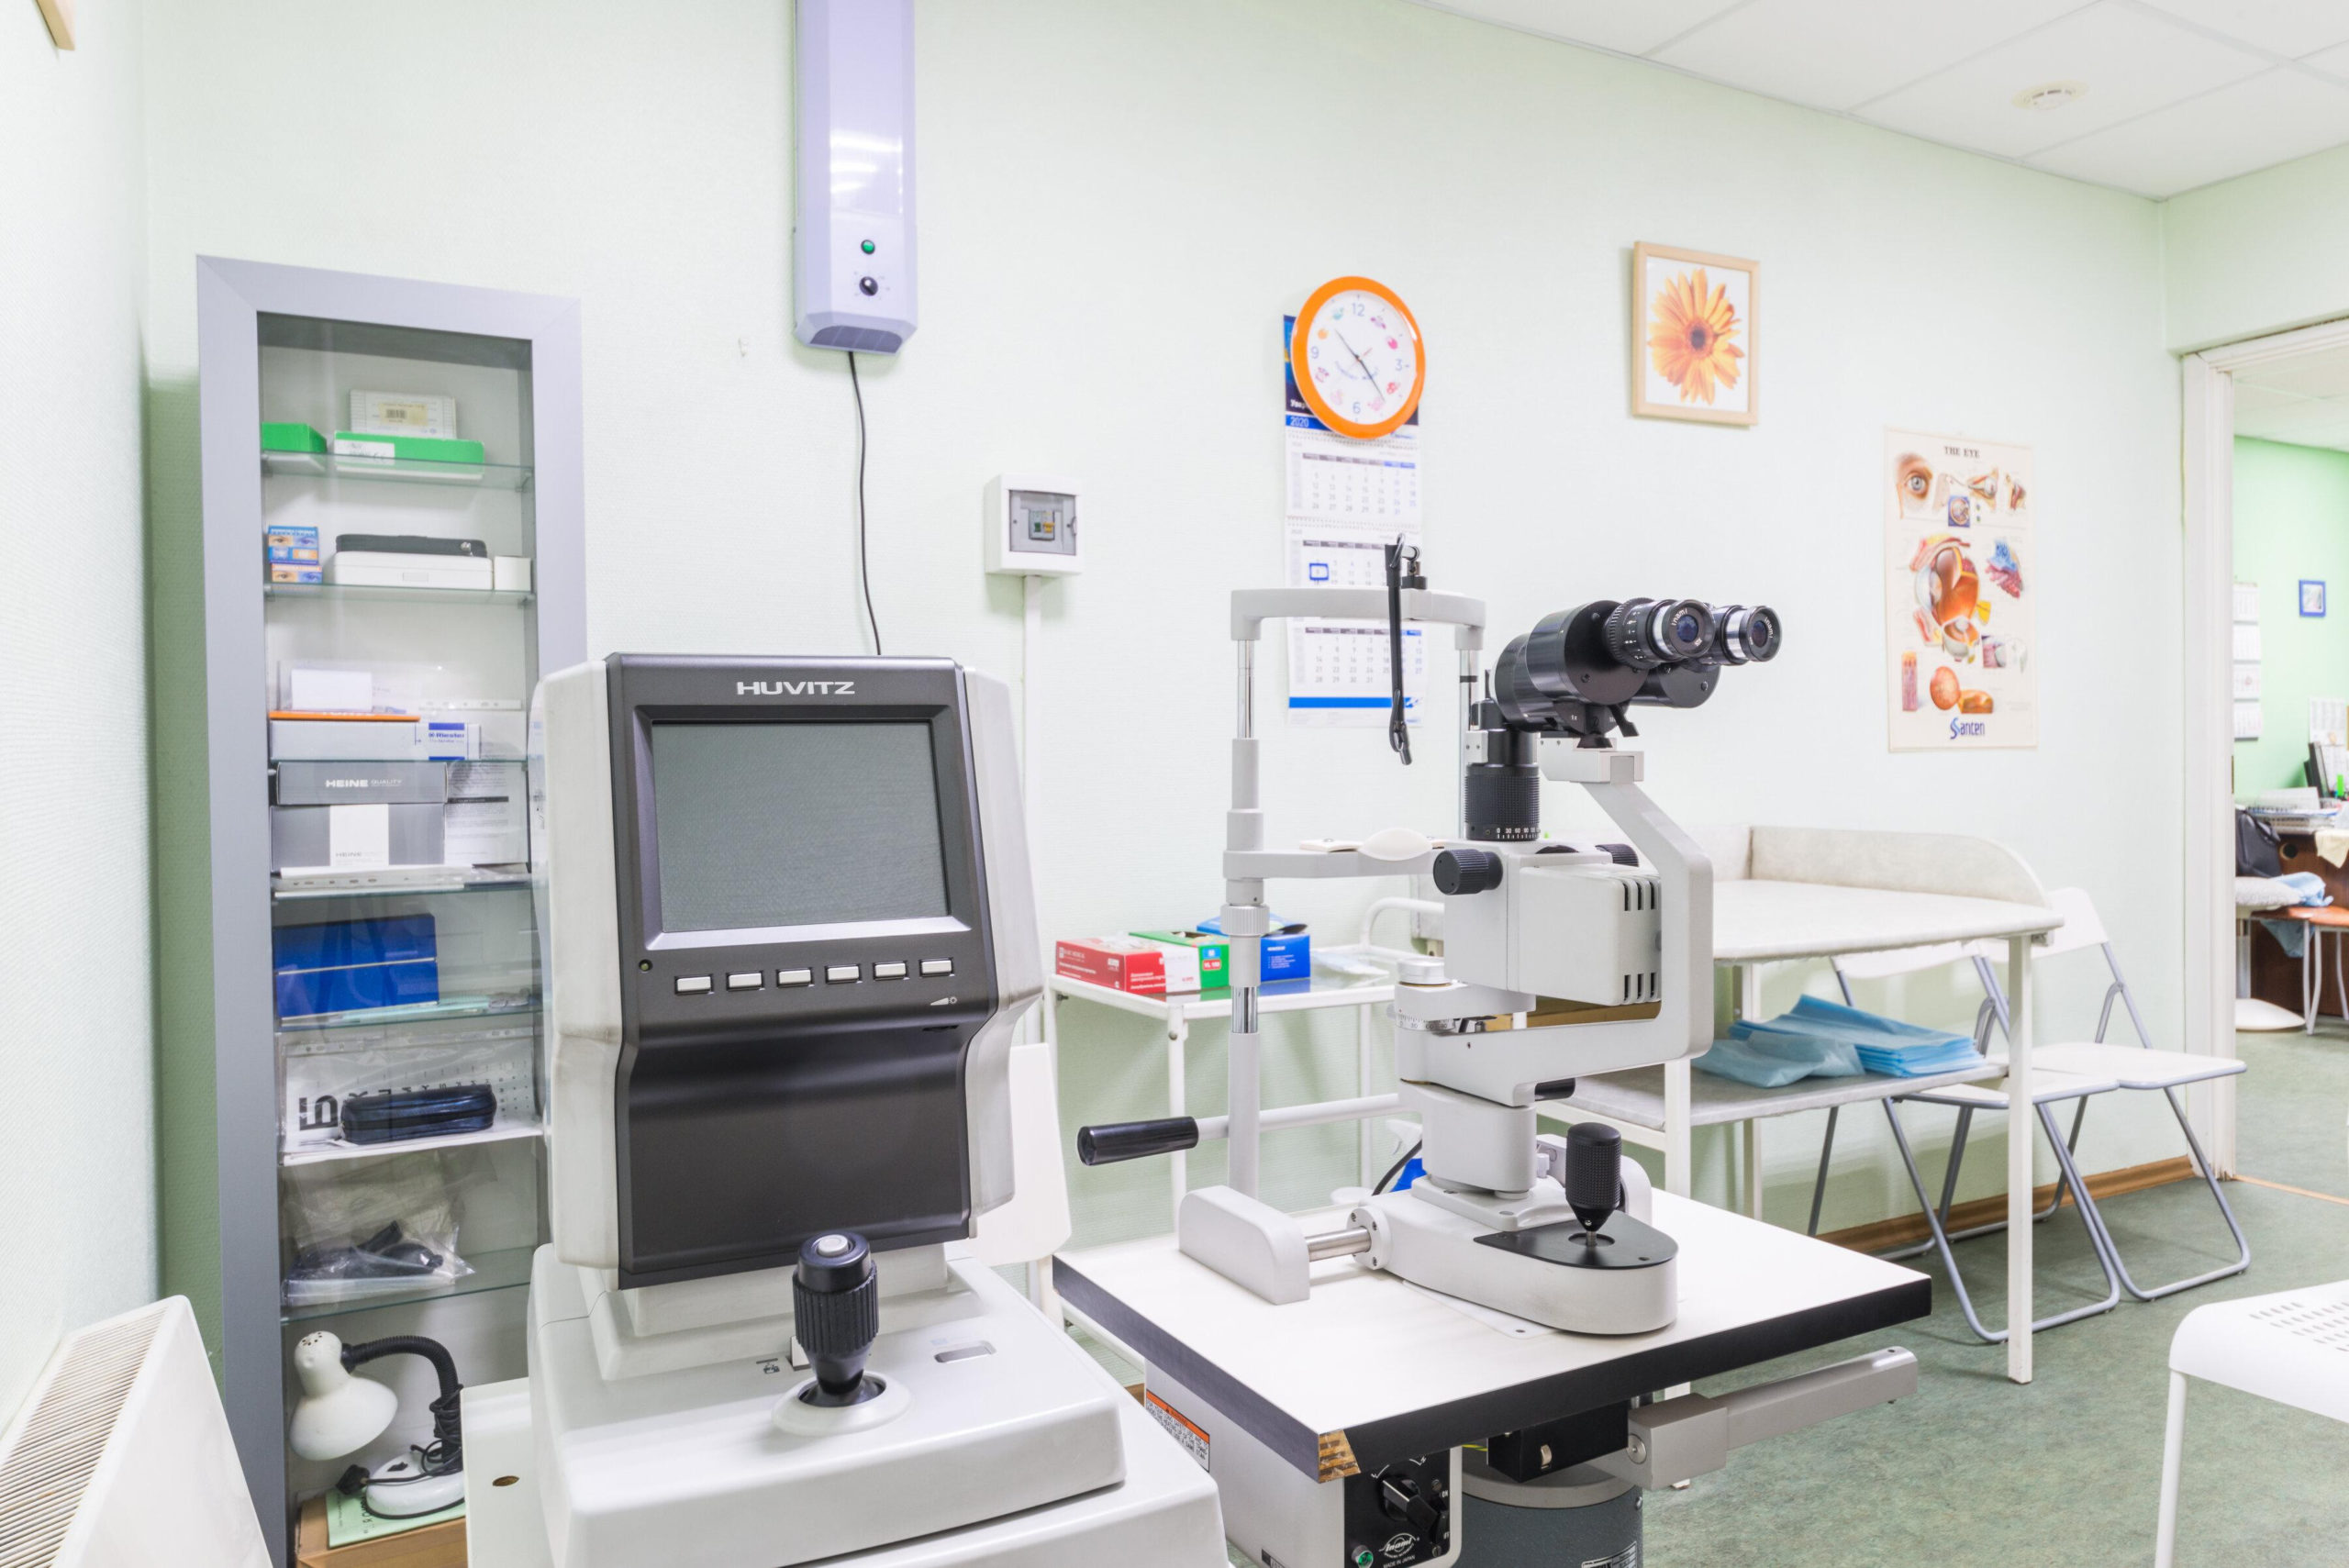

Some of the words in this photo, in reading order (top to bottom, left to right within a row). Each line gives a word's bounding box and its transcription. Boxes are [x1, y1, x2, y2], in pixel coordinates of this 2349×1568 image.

[1352, 303, 1365, 317] 12
[1310, 346, 1319, 359] 9
[1395, 359, 1403, 372] 3
[1353, 402, 1361, 414] 6
[1290, 417, 1309, 428] 2020
[1944, 446, 1961, 456] THE
[1964, 448, 1980, 459] EYE
[737, 682, 855, 695] HUVITZ
[1950, 717, 1986, 740] Santen
[325, 779, 369, 788] HEINE
